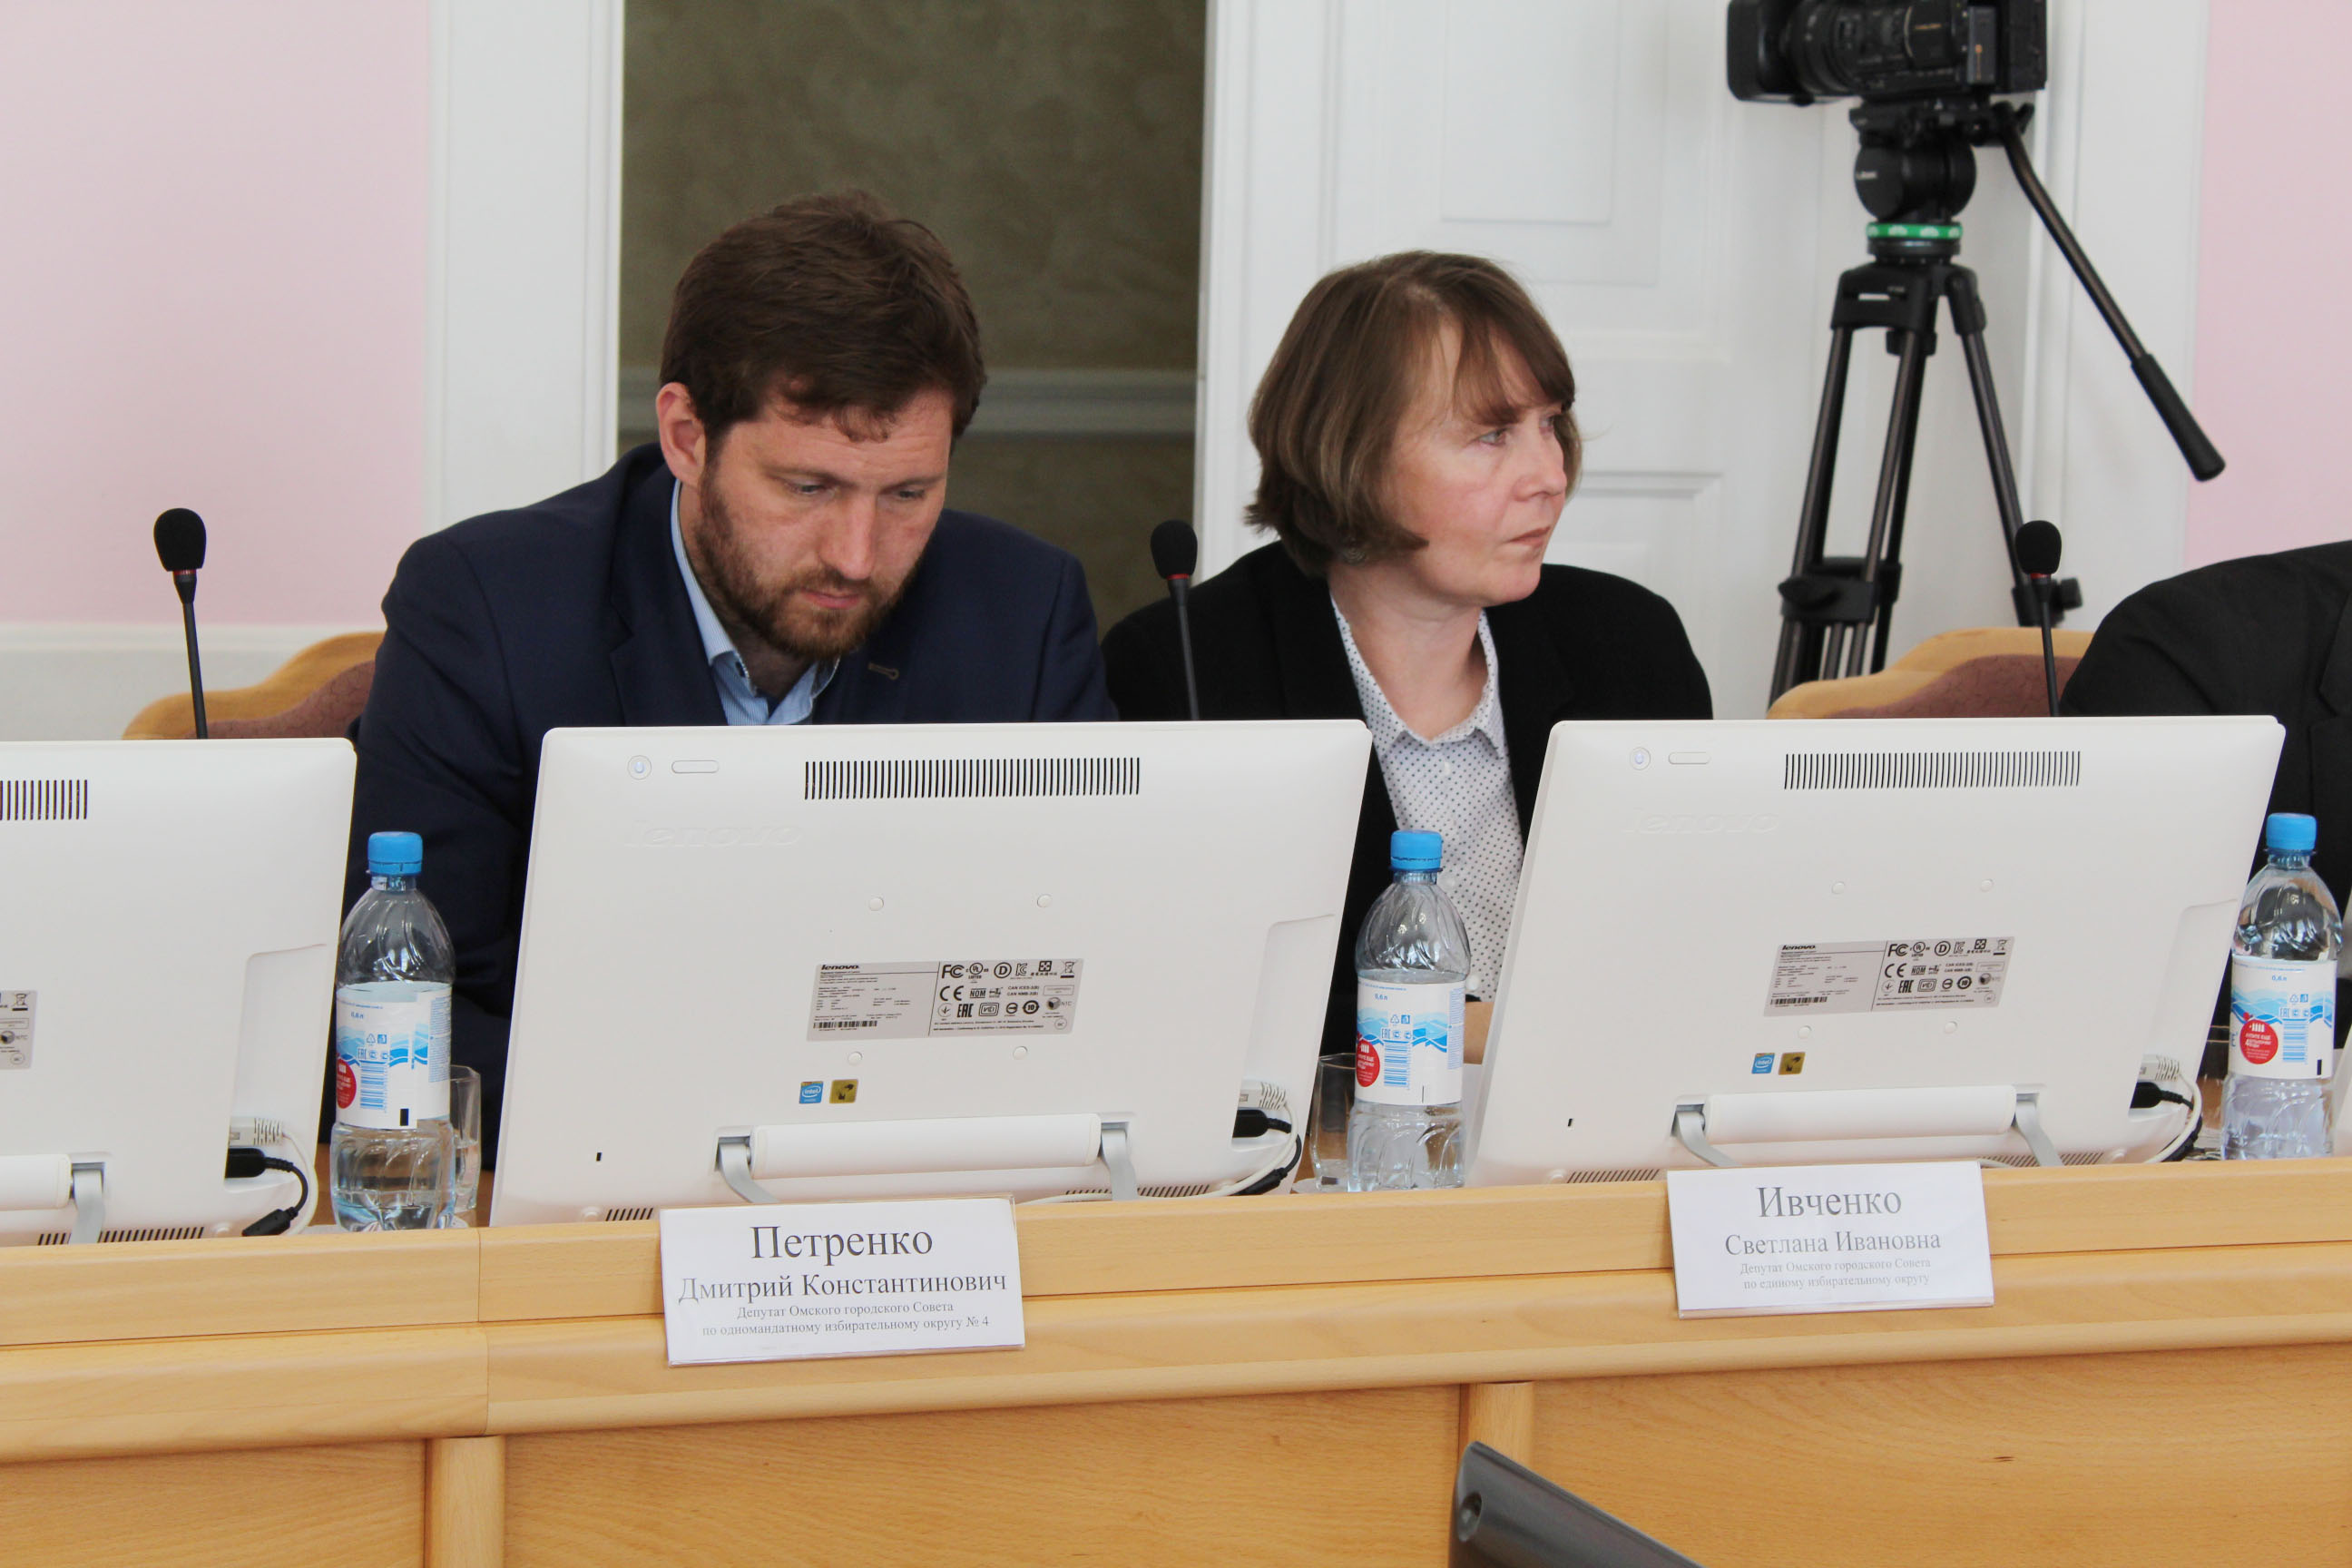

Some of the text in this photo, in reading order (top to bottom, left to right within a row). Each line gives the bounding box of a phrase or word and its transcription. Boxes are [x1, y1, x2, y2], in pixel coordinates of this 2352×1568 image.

[1757, 1186, 1902, 1218] Ивченко
[750, 1225, 933, 1266] Петренко
[1725, 1230, 1941, 1255] Светлана Ивановна
[1740, 1258, 1931, 1276] Депутат Омского городского Совета
[678, 1274, 1007, 1305] Дмитрий Константинович
[1744, 1273, 1930, 1290] по единому избирательному округу
[737, 1301, 954, 1319] Депутат Омского городского Совета
[702, 1316, 989, 1337] по одномандатному избирательному округу № 4
